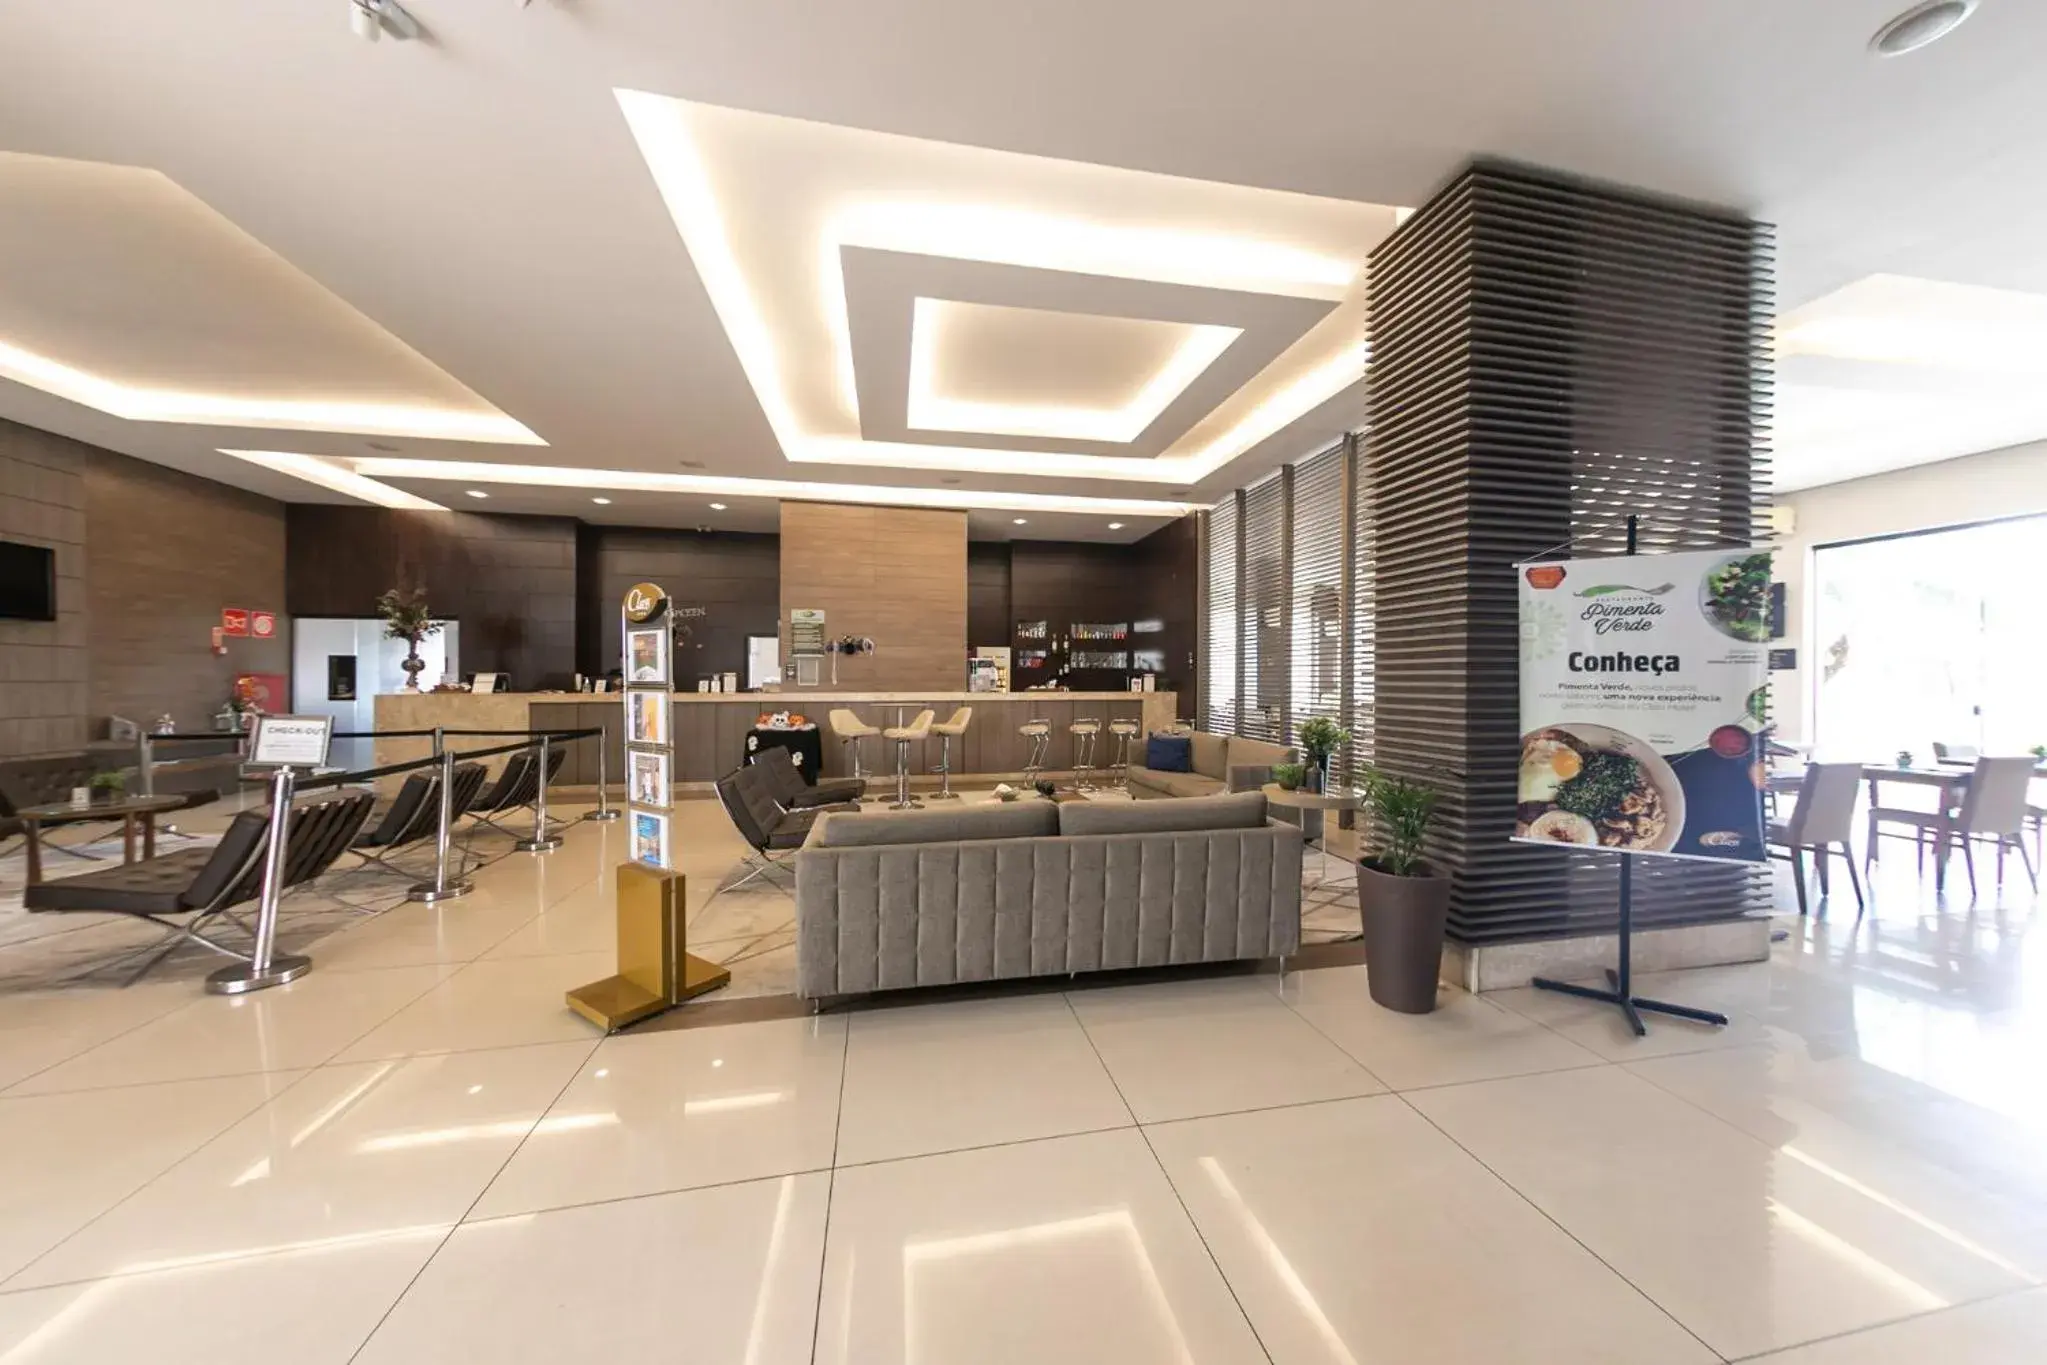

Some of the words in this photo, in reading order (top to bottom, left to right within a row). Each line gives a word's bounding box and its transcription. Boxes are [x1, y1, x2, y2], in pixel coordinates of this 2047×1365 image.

[1580, 601, 1664, 621] Pimenta
[1594, 617, 1654, 636] Verde
[1568, 651, 1680, 676] Conheça
[1558, 682, 1599, 691] Pimenta
